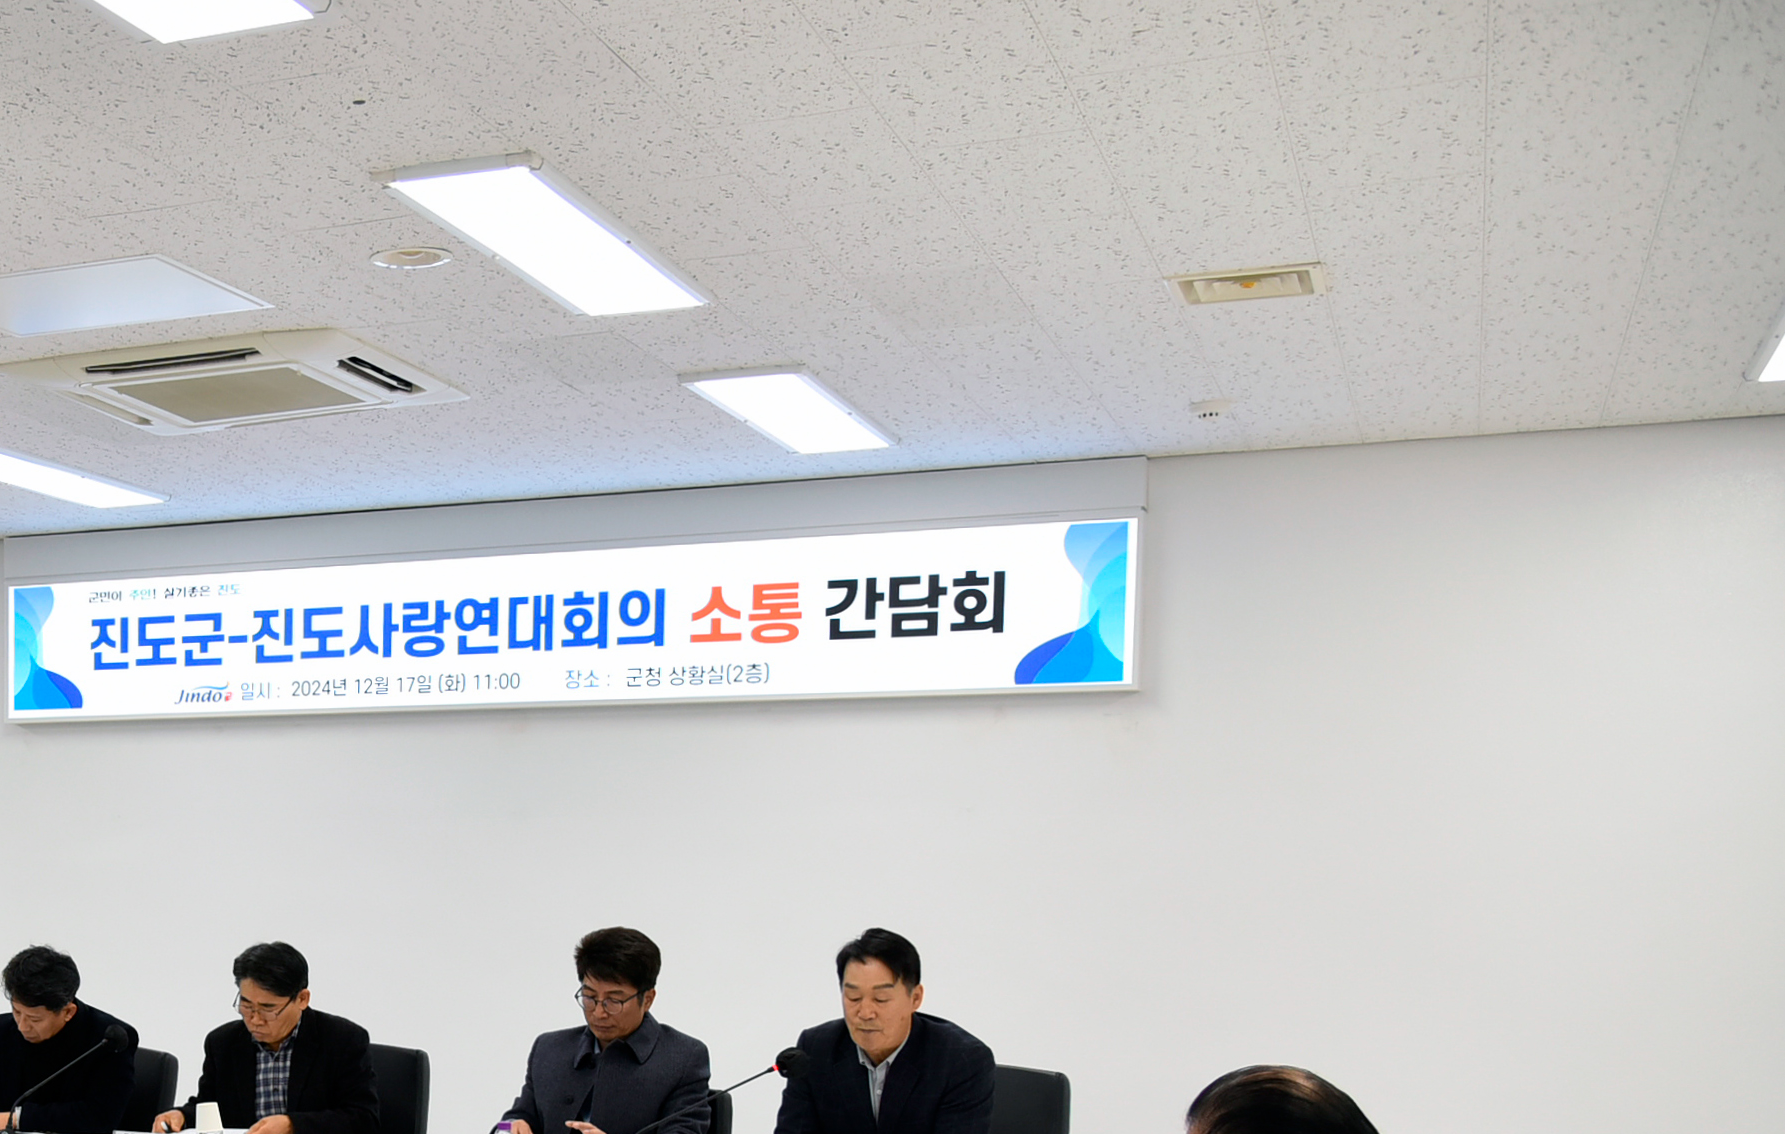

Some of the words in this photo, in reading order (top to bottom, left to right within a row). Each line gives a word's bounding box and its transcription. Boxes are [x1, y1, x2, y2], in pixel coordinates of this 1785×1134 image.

[217, 583, 243, 596] 진도
[90, 588, 665, 671] 진도군-진도사랑연대회의
[690, 582, 802, 643] 소통
[825, 570, 1006, 641] 간담회
[240, 681, 271, 701] 일시
[291, 678, 347, 698] 2024년
[354, 675, 389, 695] 12월
[396, 674, 432, 694] 17일
[438, 672, 466, 693] (화)
[473, 672, 521, 691] 11:00
[565, 669, 600, 690] 장소
[625, 666, 662, 688] 군청
[668, 662, 770, 687] 상황실(2층)
[174, 685, 225, 704] Jindo
